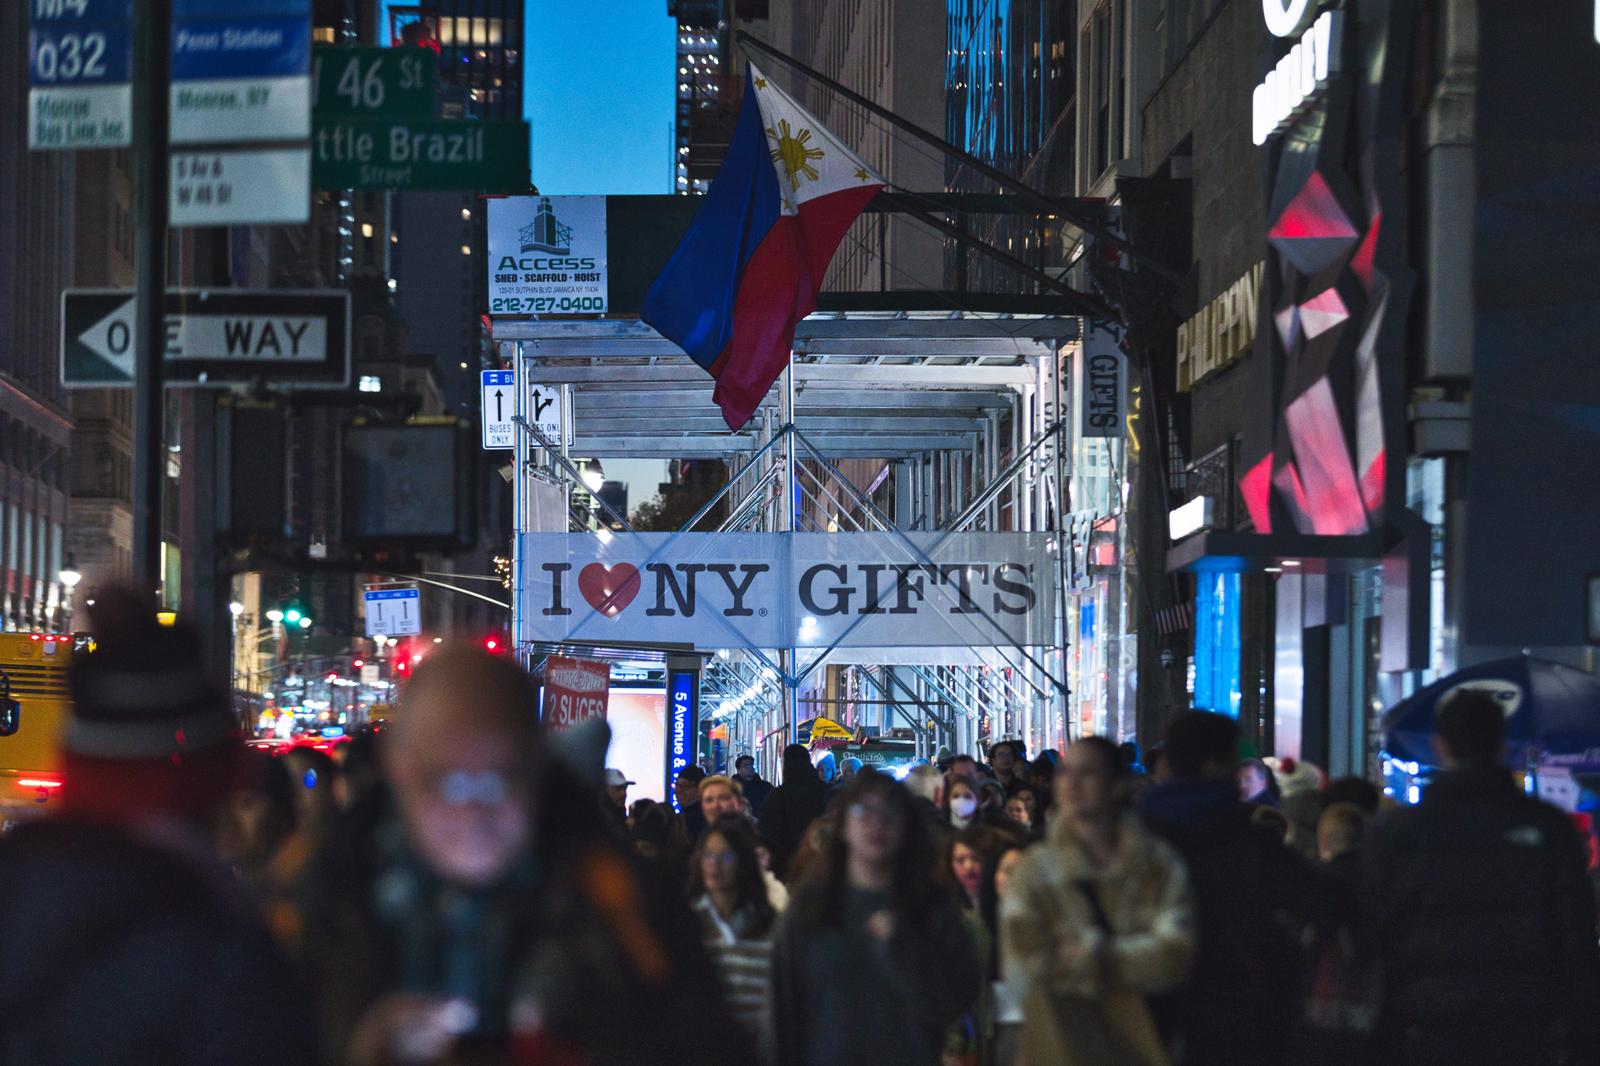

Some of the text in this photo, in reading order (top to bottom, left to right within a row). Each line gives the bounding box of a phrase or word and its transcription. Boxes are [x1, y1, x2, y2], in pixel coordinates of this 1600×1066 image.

[37, 32, 107, 80] Q32
[338, 57, 384, 107] 46
[400, 56, 424, 89] St
[317, 126, 483, 162] ttle Brazil
[360, 164, 413, 184] Street
[498, 256, 596, 271] Access
[495, 272, 601, 283] SHED SCAFFOLD HOIST
[515, 286, 539, 294] SUTPHIN
[539, 286, 552, 294] BLVD
[576, 285, 583, 293] NY
[492, 296, 604, 312] 212-727-0400
[106, 319, 310, 355] OE WAY
[1089, 355, 1119, 429] GIFTS
[489, 424, 511, 433] BUSES
[546, 423, 560, 432] ONL
[491, 435, 509, 445] ONLY
[541, 562, 572, 616] I
[799, 562, 1037, 617] GIFTS
[674, 692, 687, 701] 5
[548, 693, 604, 725] 2 SLICES
[674, 704, 687, 754] Avenue
[673, 758, 687, 768] &
